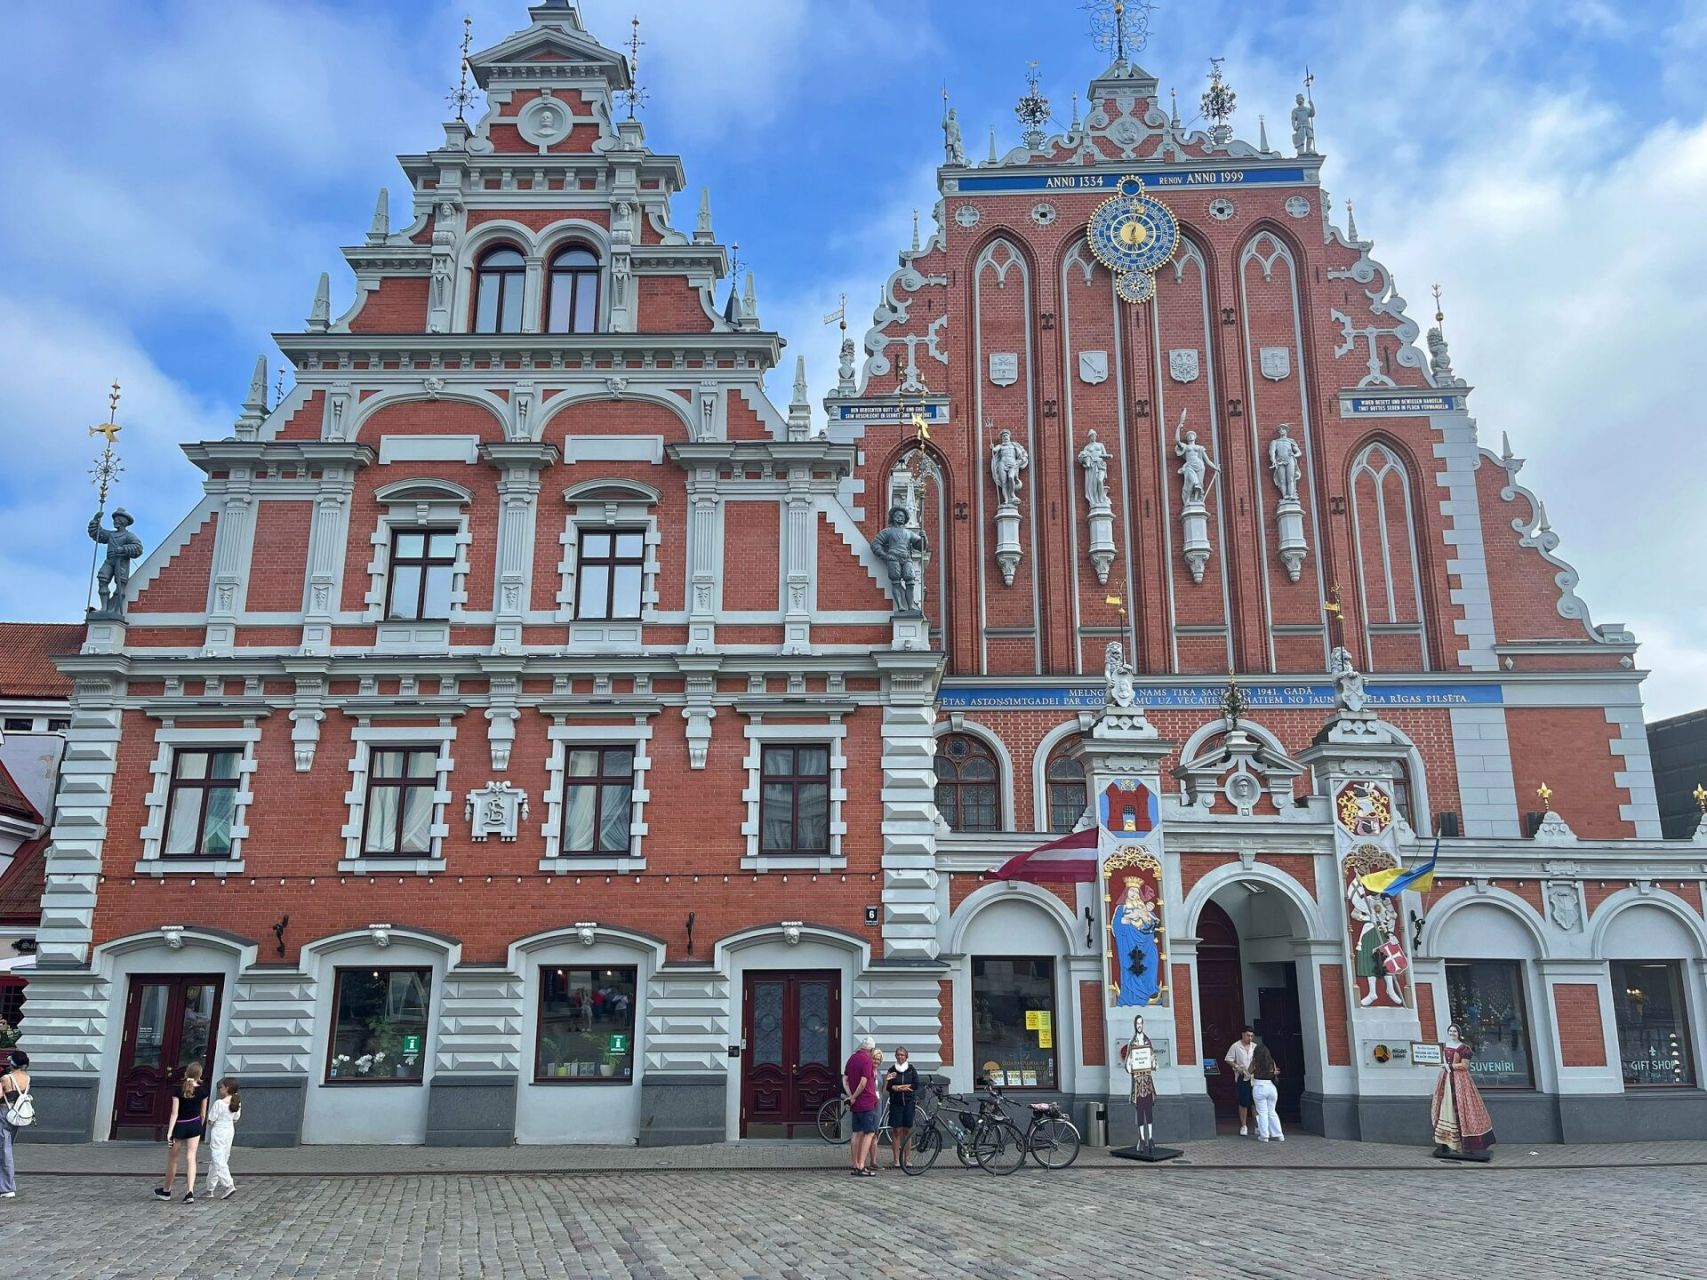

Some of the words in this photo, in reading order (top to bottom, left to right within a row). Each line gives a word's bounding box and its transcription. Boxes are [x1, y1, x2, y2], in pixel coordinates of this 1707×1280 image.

[1046, 177, 1075, 187] ANNO
[1080, 176, 1104, 187] 1334
[1186, 172, 1217, 184] ANNO
[1220, 171, 1244, 182] 1999
[1139, 688, 1167, 696] NAMS
[1172, 688, 1196, 696] TIKA
[1201, 687, 1251, 697] SAGRTS
[1063, 697, 1082, 705] PAR
[1158, 697, 1172, 705] UZ
[1288, 696, 1304, 704] NO
[1309, 695, 1335, 705] JAUN
[1390, 694, 1421, 703] RĪGAS
[869, 910, 875, 919] 6
[1470, 1060, 1515, 1072] SUVENĪRI
[1631, 1060, 1650, 1071] GIFT
[1651, 1060, 1677, 1070] SHOP
